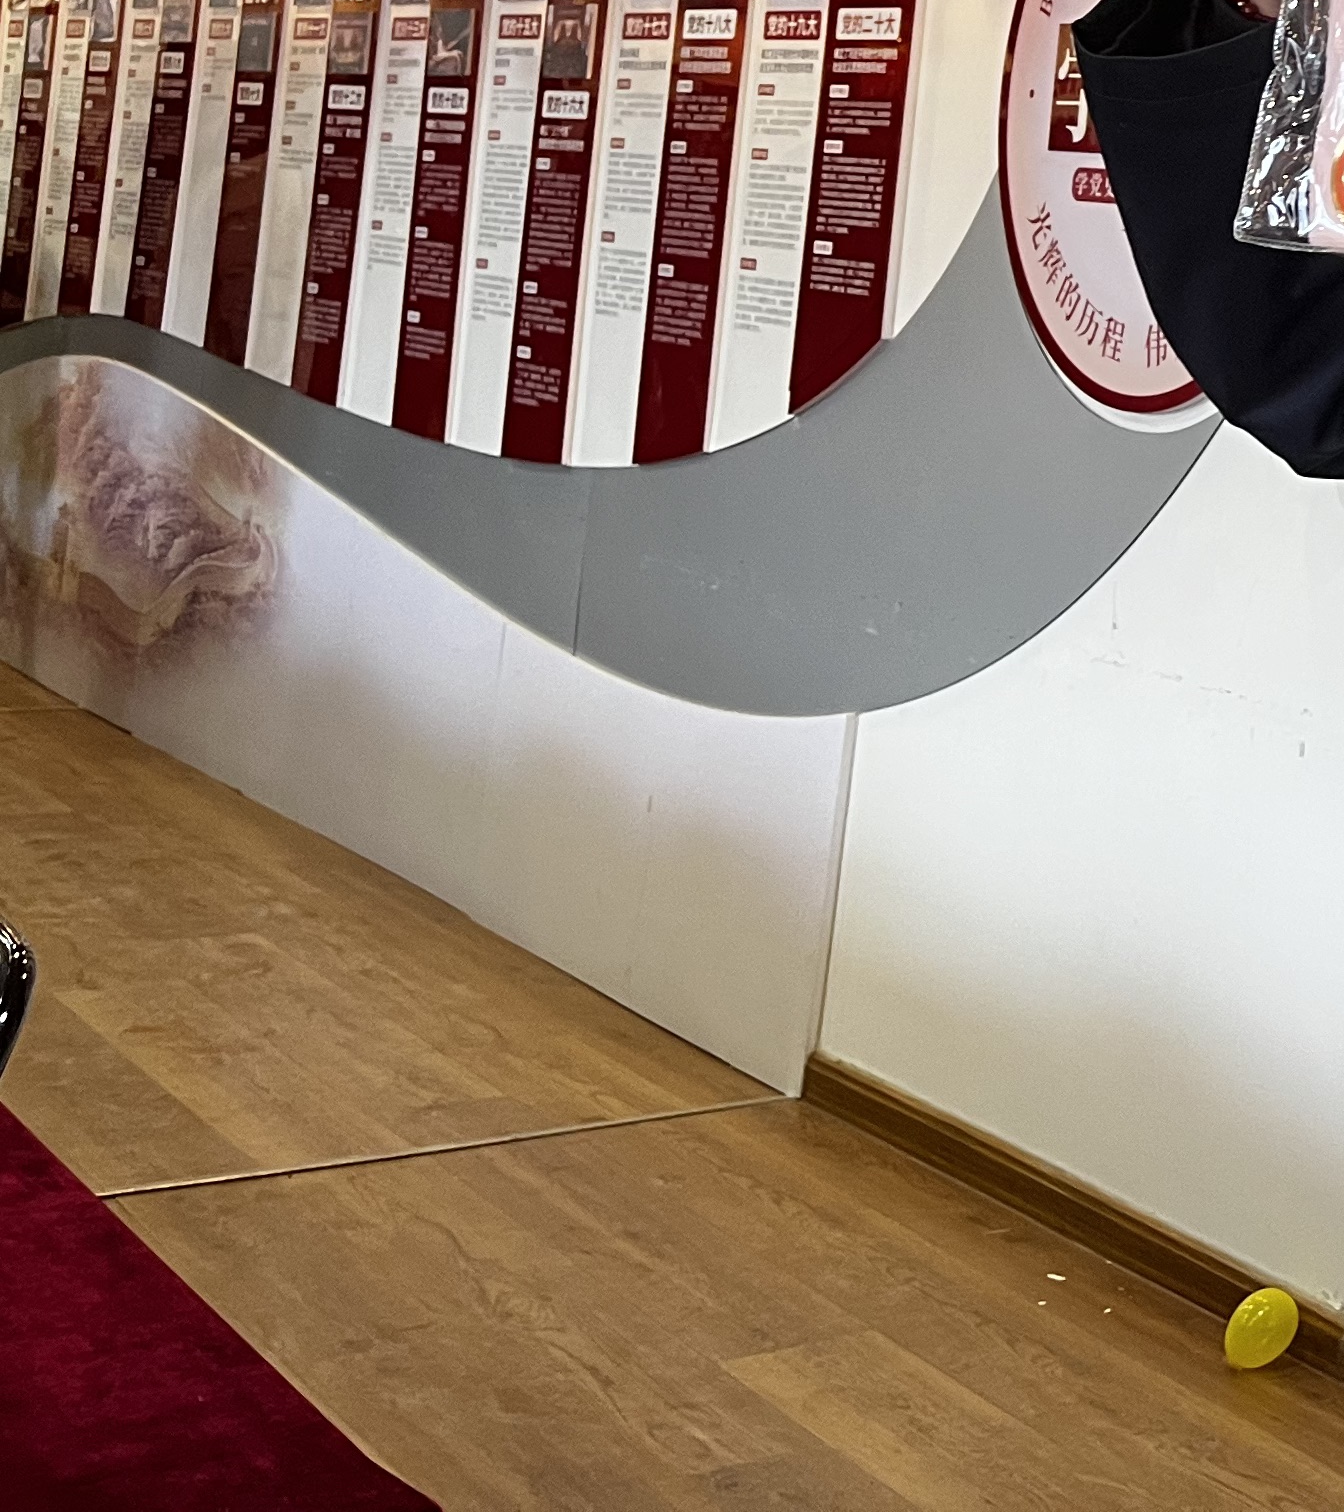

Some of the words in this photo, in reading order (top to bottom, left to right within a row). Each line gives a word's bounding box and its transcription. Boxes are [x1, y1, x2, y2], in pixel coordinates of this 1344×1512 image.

[687, 14, 732, 35] 党的十八大
[766, 14, 818, 36] 党的十九大
[841, 12, 896, 35] 党的二十大
[1027, 201, 1125, 362] 光辉的历程
